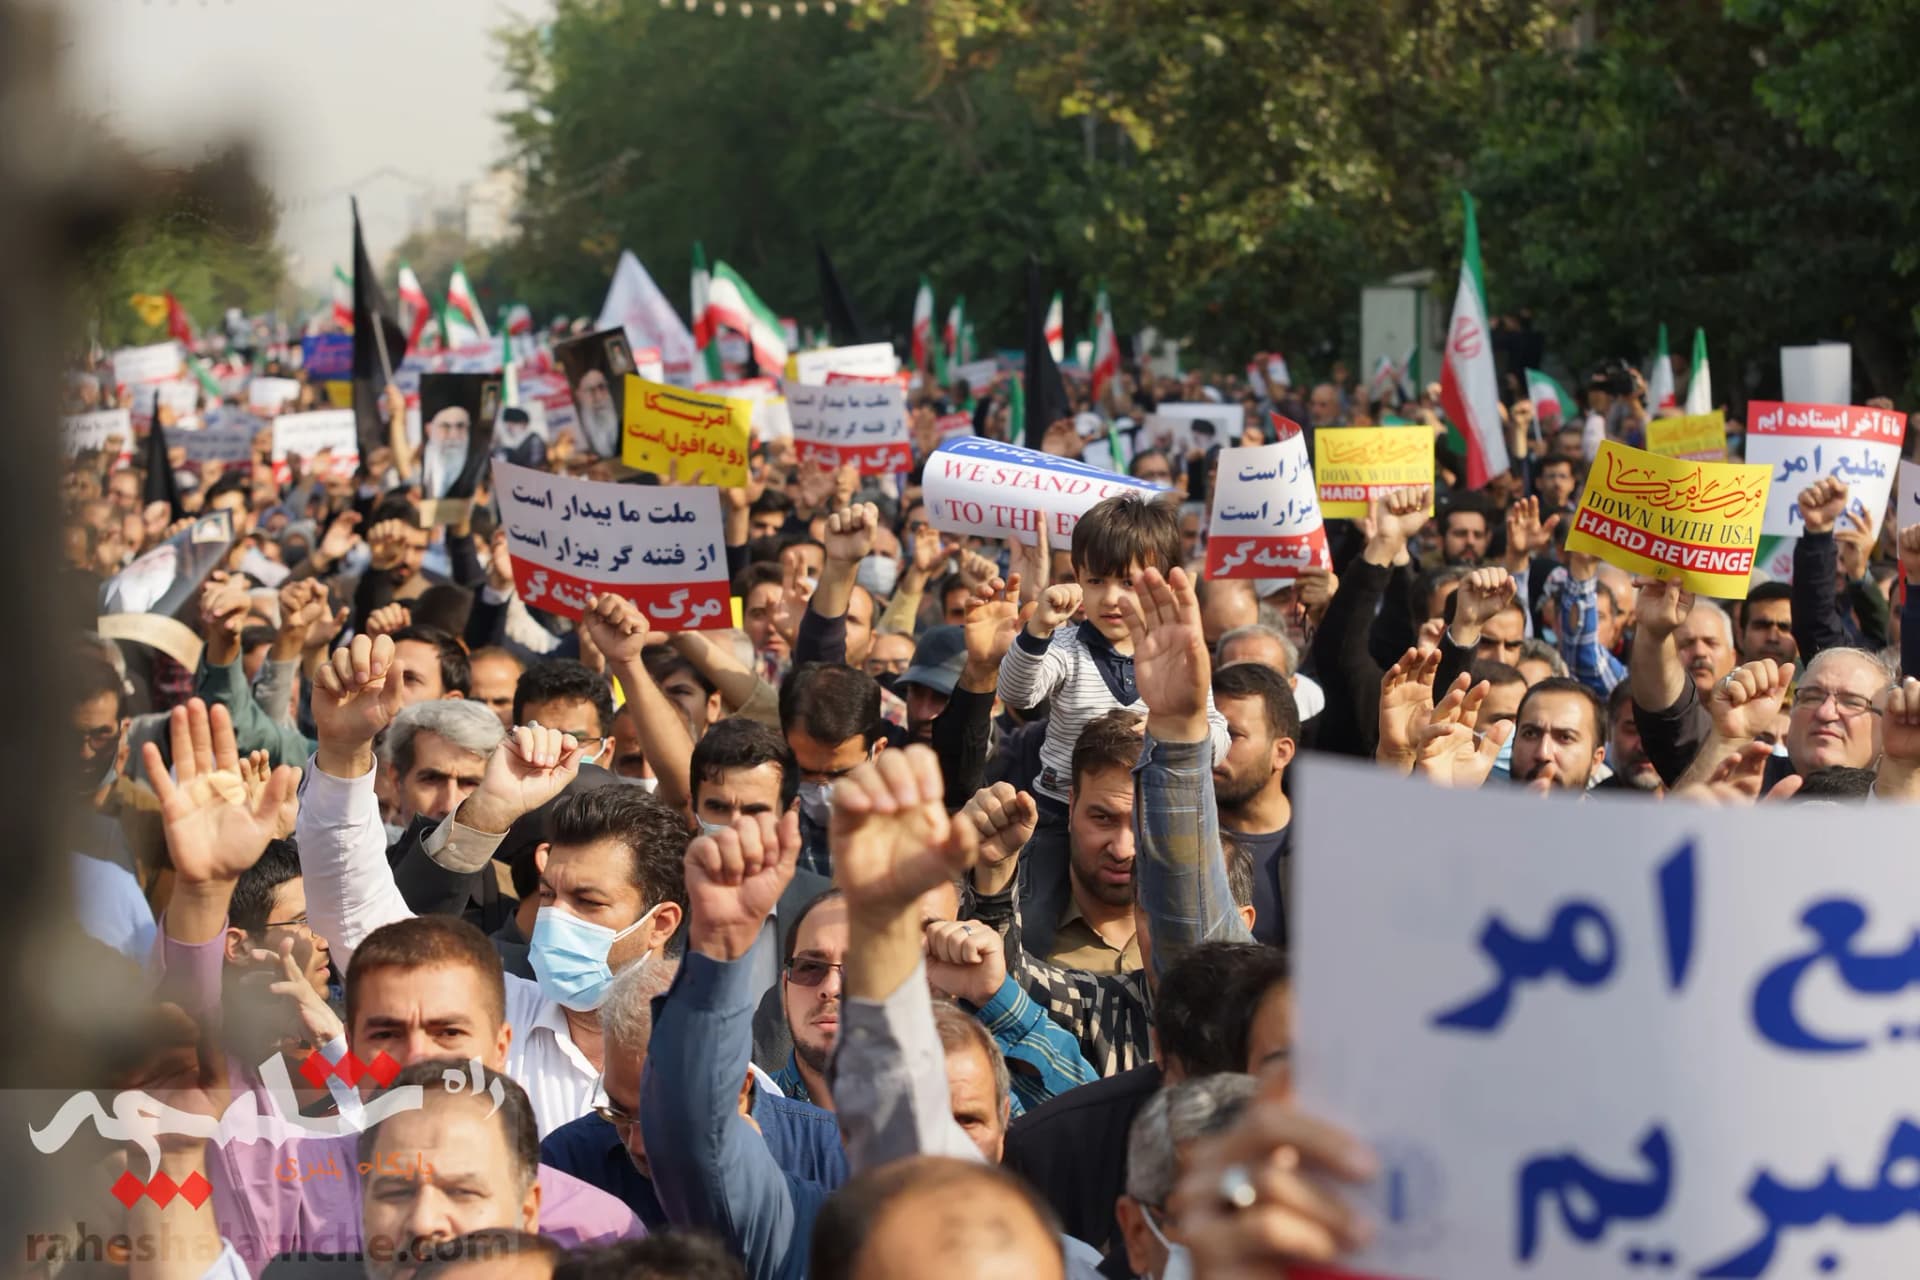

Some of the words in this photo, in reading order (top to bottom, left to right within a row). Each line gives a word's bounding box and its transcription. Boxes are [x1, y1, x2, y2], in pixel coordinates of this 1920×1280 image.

[1238, 458, 1285, 482] است
[1774, 444, 1822, 483] امر
[943, 459, 990, 482] WE
[991, 467, 1091, 496] STAND
[511, 485, 553, 510] است
[1321, 486, 1366, 500] HARD
[560, 495, 612, 527] بیدار
[618, 500, 641, 523] ما
[648, 501, 697, 524] ملت
[945, 499, 984, 525] TO
[1220, 501, 1268, 521] است
[1587, 490, 1654, 529] DOWN
[1660, 516, 1714, 543] WITH
[1720, 525, 1753, 545] USA
[508, 524, 548, 549] است
[1578, 511, 1646, 551] HARD
[1650, 540, 1752, 572] REVENGE
[555, 536, 599, 568] بیزار
[607, 545, 633, 572] گر
[641, 543, 686, 566] فتنه
[694, 543, 716, 572] از
[648, 588, 723, 628] مرگ
[1427, 835, 1699, 1034] امر
